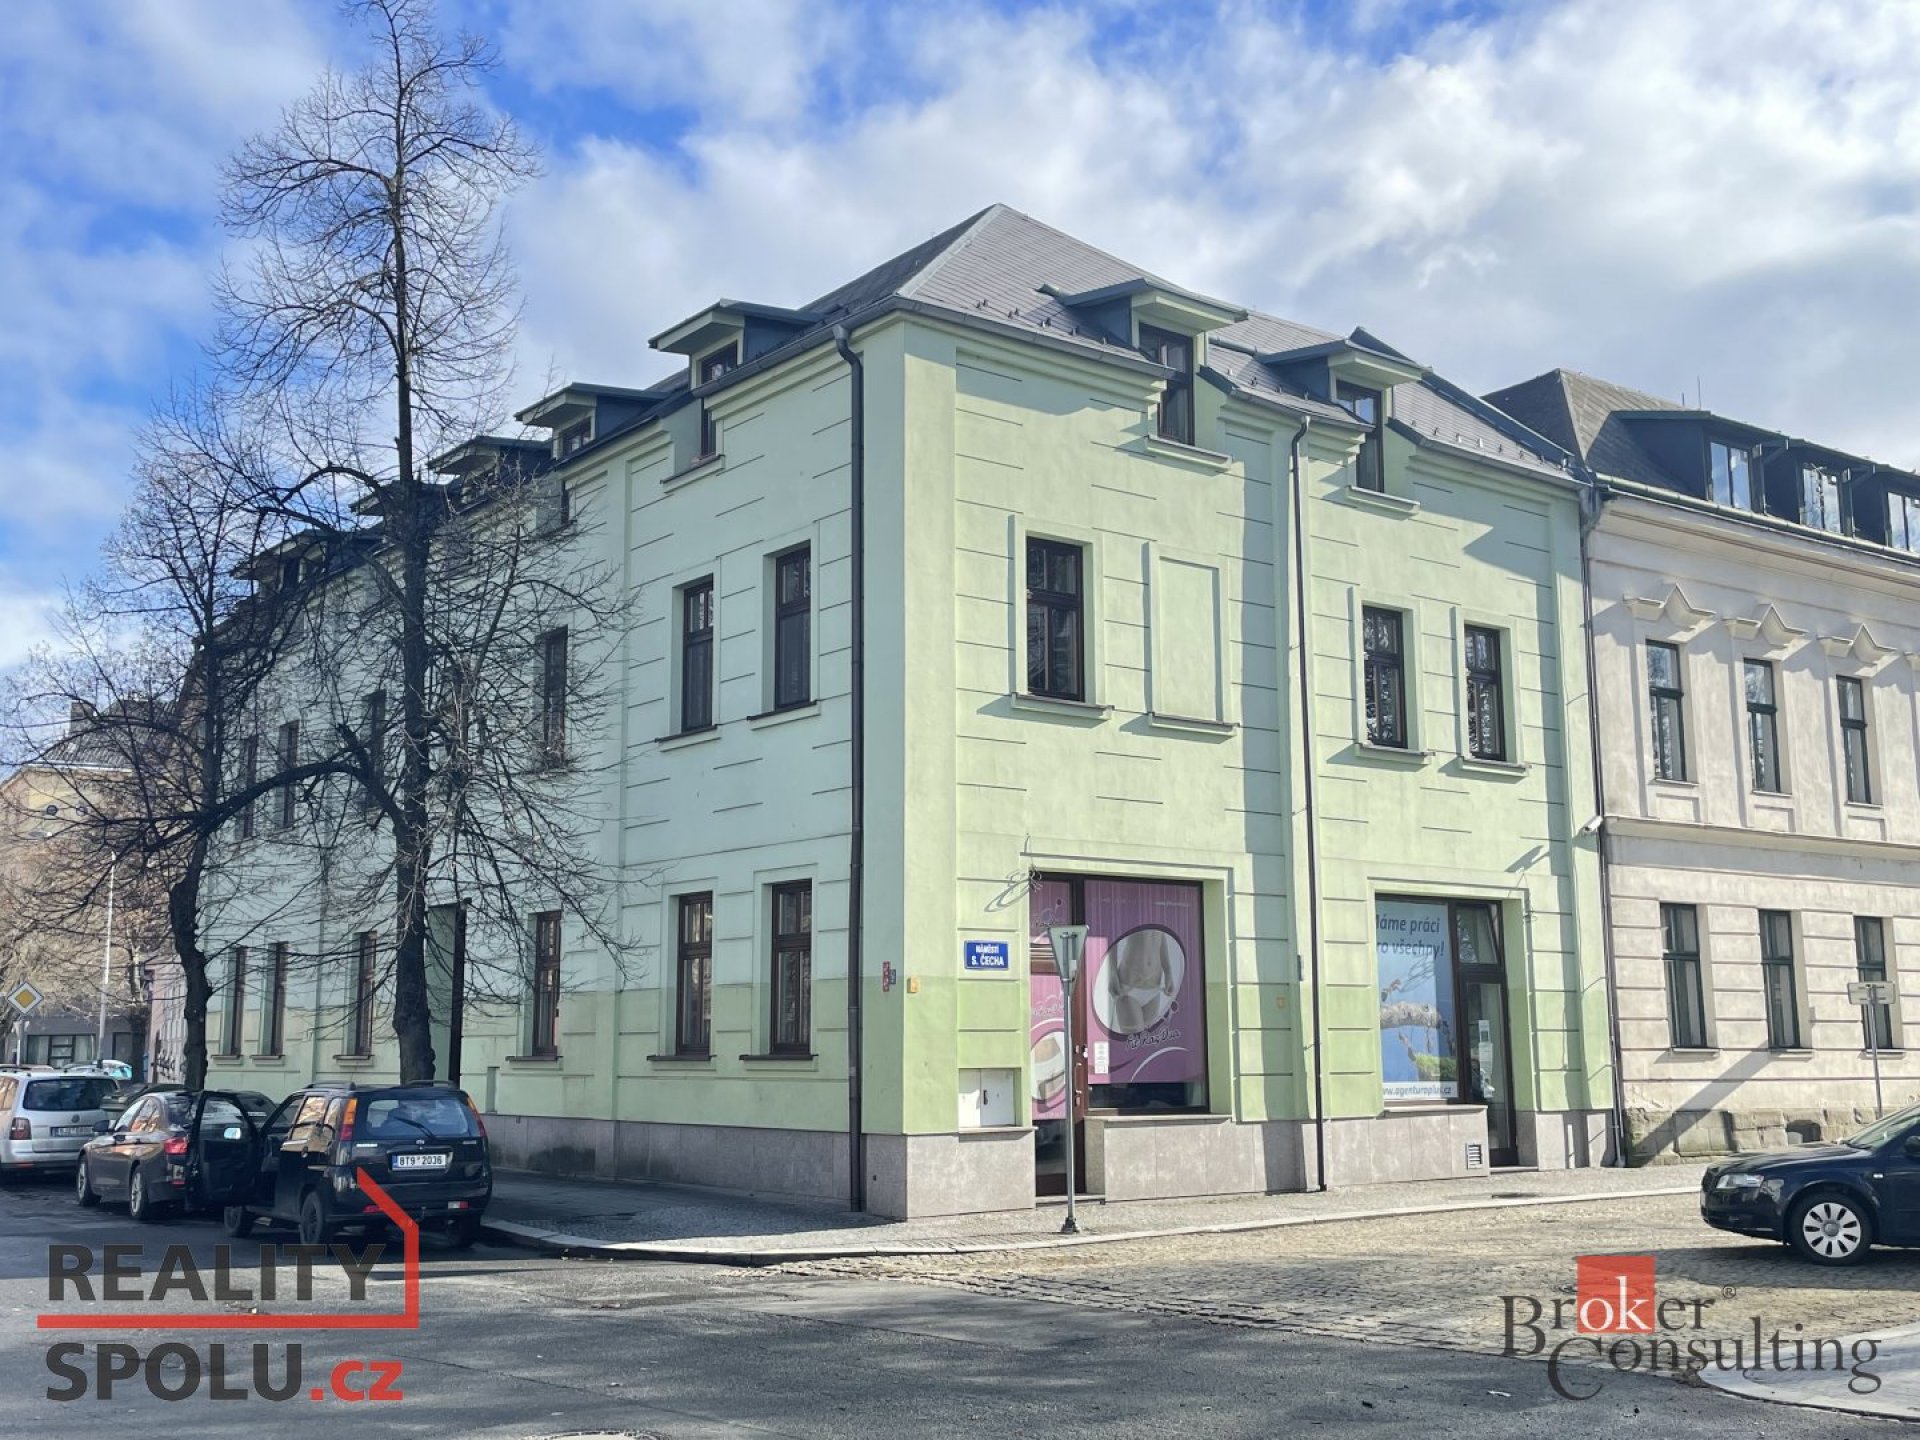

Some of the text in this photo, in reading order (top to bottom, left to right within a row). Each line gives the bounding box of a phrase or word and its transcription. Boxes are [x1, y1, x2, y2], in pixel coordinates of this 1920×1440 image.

[1409, 916, 1440, 935] práci
[1392, 940, 1445, 961] všechny!
[971, 952, 1005, 966] S. ČECHA
[399, 1155, 416, 1166] 8T9
